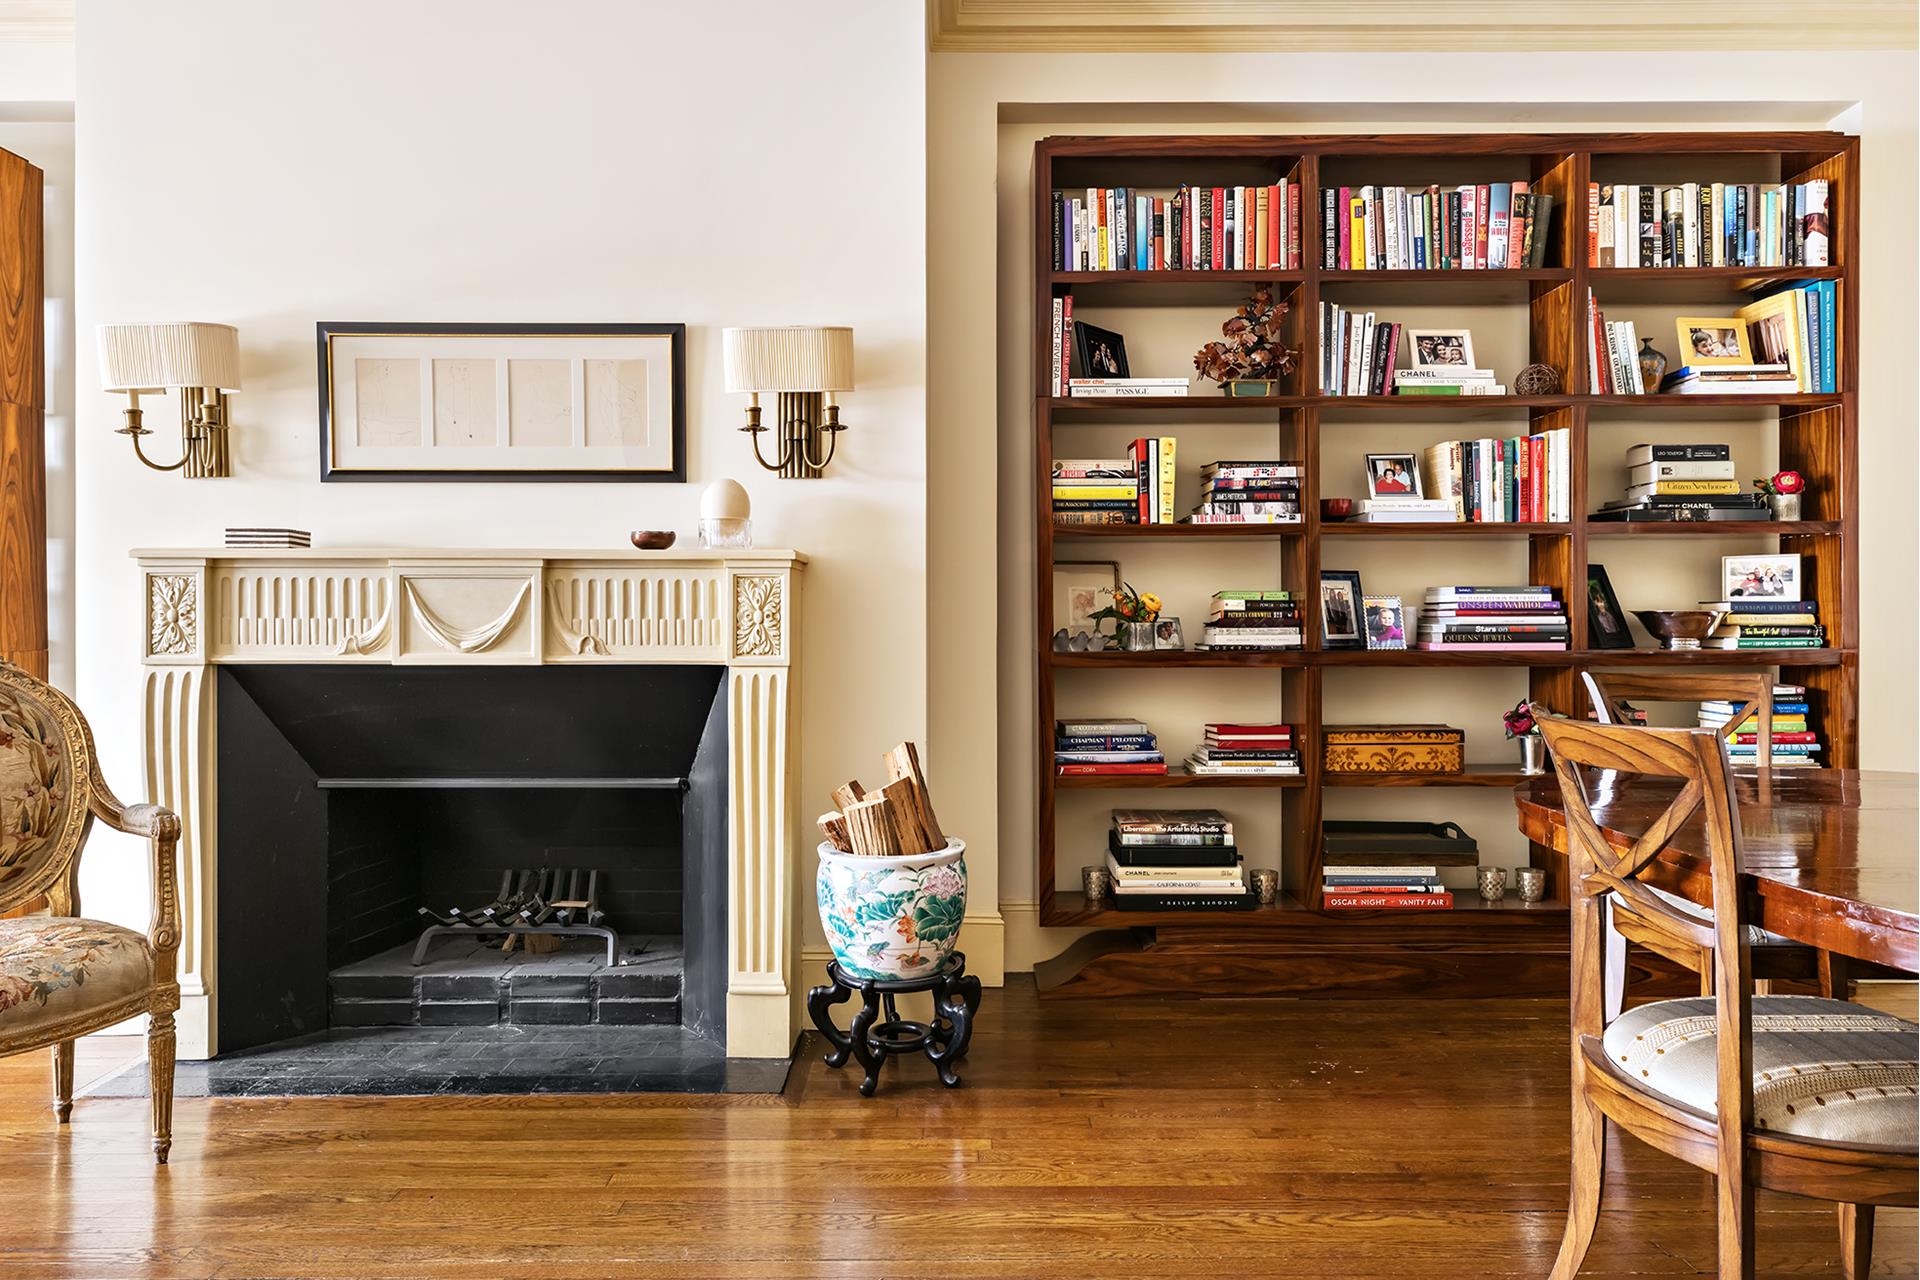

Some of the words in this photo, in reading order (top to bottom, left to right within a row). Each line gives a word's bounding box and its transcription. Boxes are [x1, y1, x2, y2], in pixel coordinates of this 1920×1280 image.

[1589, 188, 1598, 234] AIRFRAME
[1462, 218, 1473, 256] passages
[1667, 482, 1692, 490] Citizen
[1693, 482, 1728, 490] Newhouse
[1444, 634, 1480, 642] QUEENS'
[1482, 634, 1512, 642] JEWELS
